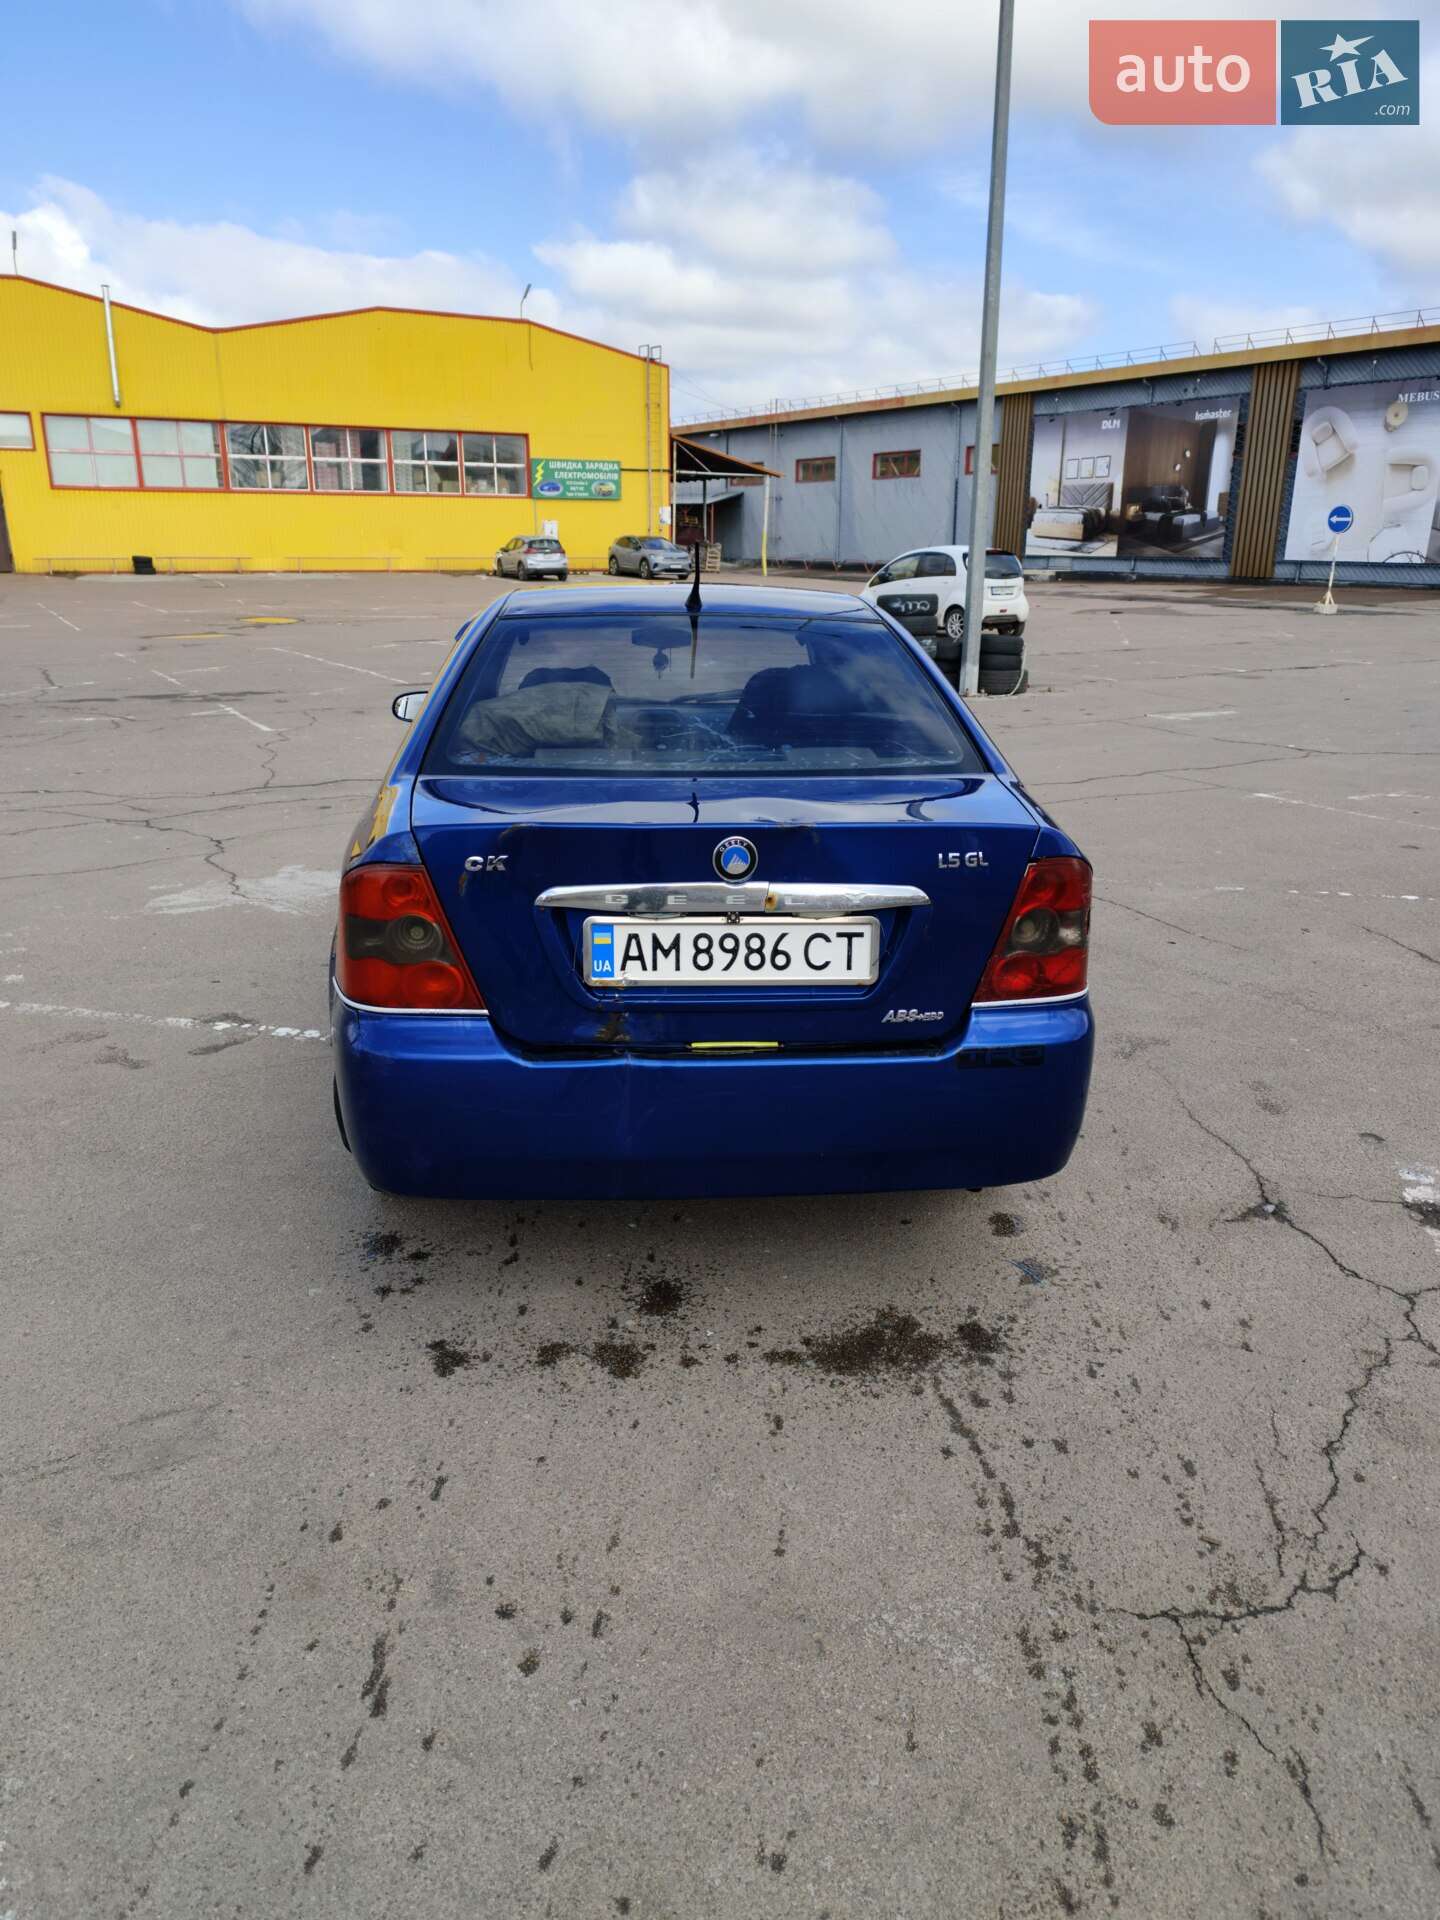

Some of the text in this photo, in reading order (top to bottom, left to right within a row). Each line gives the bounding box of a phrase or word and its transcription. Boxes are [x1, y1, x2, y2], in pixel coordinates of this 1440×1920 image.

[549, 461, 619, 471] ШВИДКА ЗАРЯДКА
[554, 471, 619, 480] ЕЛЕКТРОМОБІЛІВ
[464, 855, 509, 872] CK
[965, 851, 989, 867] GL
[605, 893, 868, 906] GEELY
[620, 932, 865, 972] AM 8986 CT
[593, 959, 612, 973] UA
